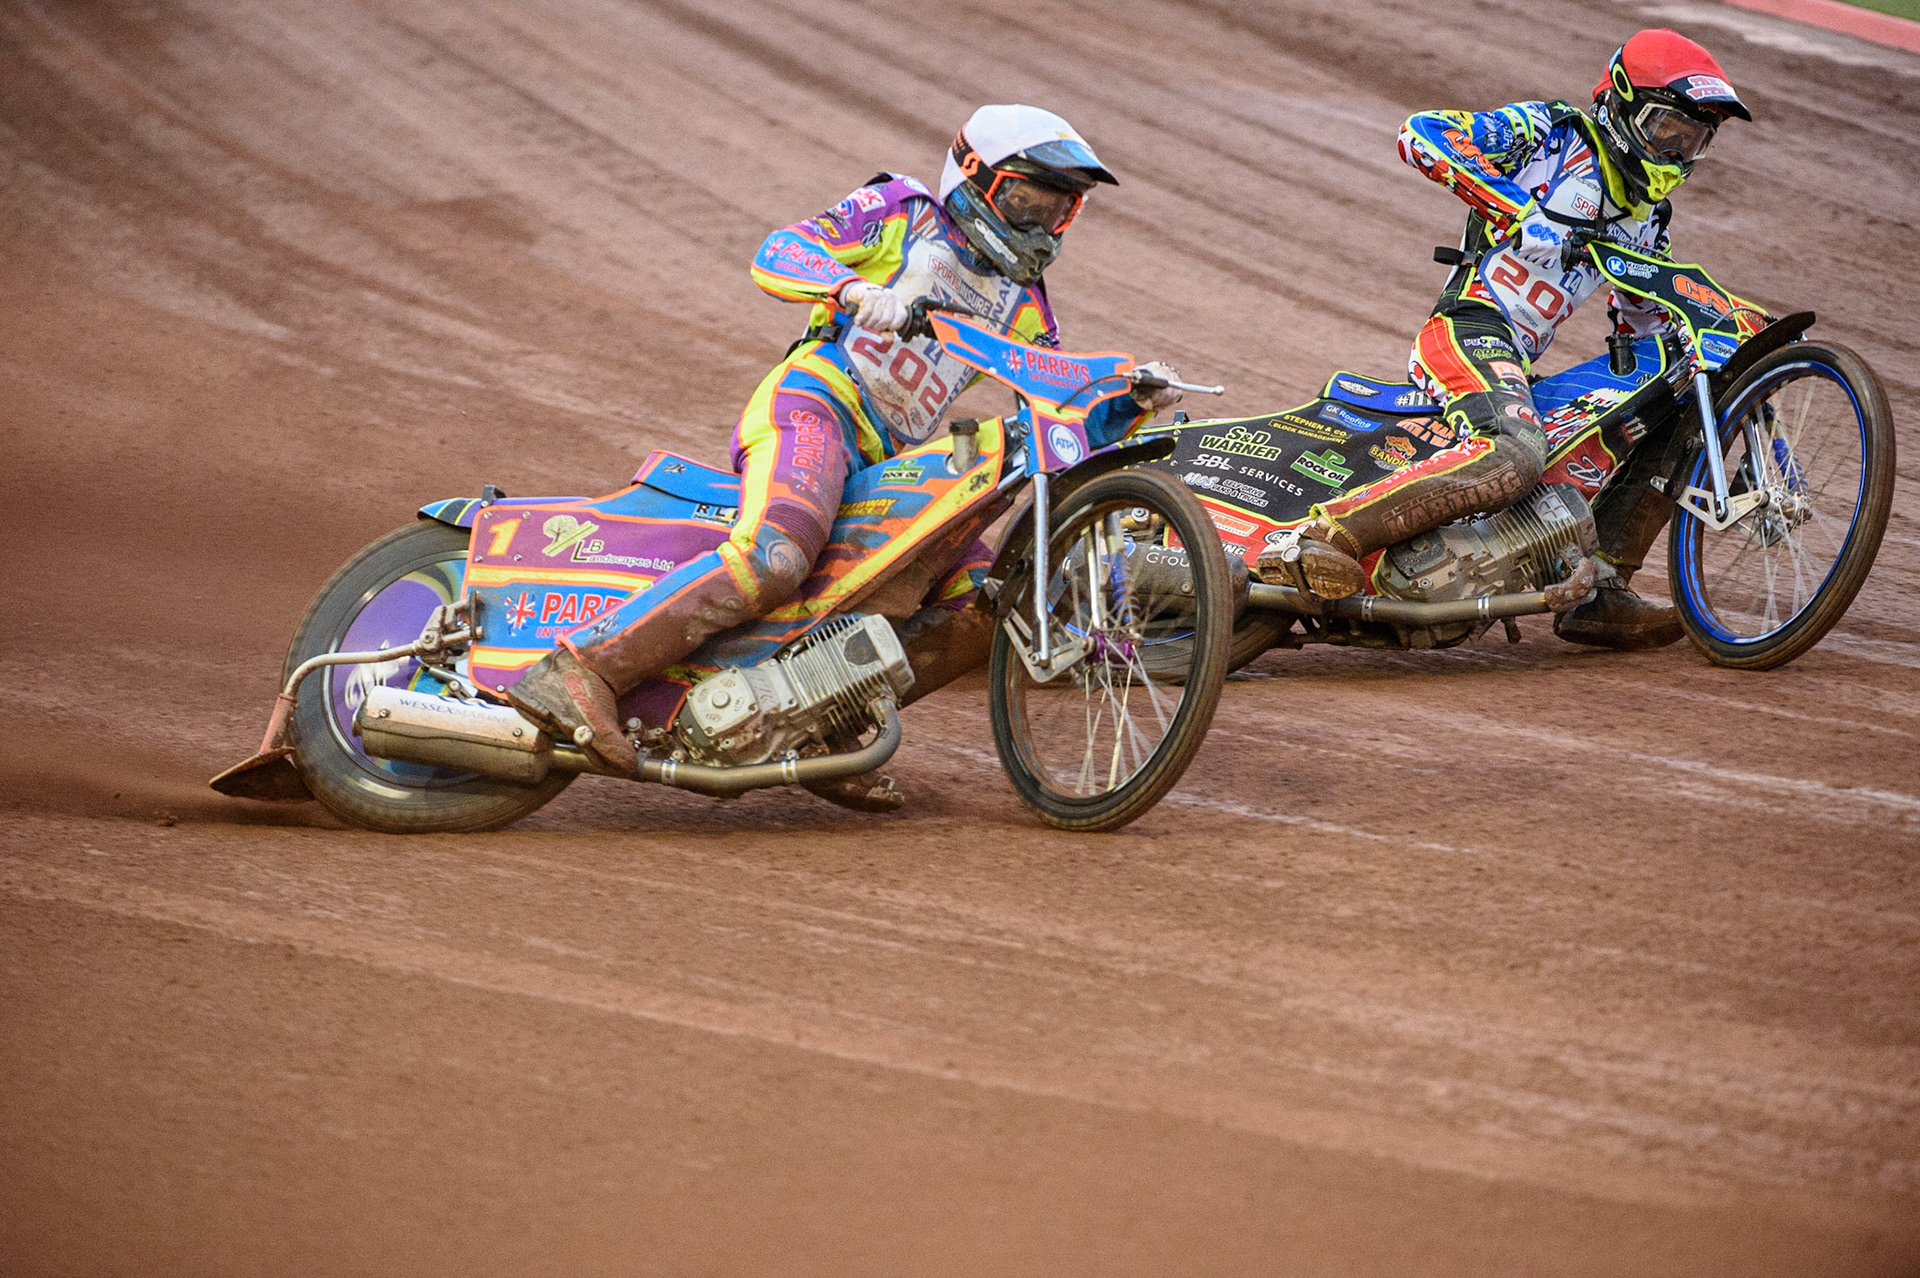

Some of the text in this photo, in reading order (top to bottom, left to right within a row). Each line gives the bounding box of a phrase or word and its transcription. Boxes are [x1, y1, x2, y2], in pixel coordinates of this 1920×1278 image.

[931, 257, 992, 319] SPORTS INSURE
[1025, 351, 1091, 385] PARRYS
[1284, 414, 1324, 431] STEPHEN
[1326, 404, 1339, 414] GK
[1339, 410, 1371, 429] Roofing
[1226, 427, 1271, 446] S&D
[1273, 422, 1297, 433] BLOCK
[1297, 429, 1347, 445] MANAGEMENT
[1200, 435, 1281, 461] WARNER
[1193, 454, 1305, 497] SBL SERVICES
[1297, 457, 1346, 482] ROCK OIL
[1237, 492, 1269, 508] TRUCKS
[488, 518, 522, 557] 1
[652, 559, 675, 572] Ltd
